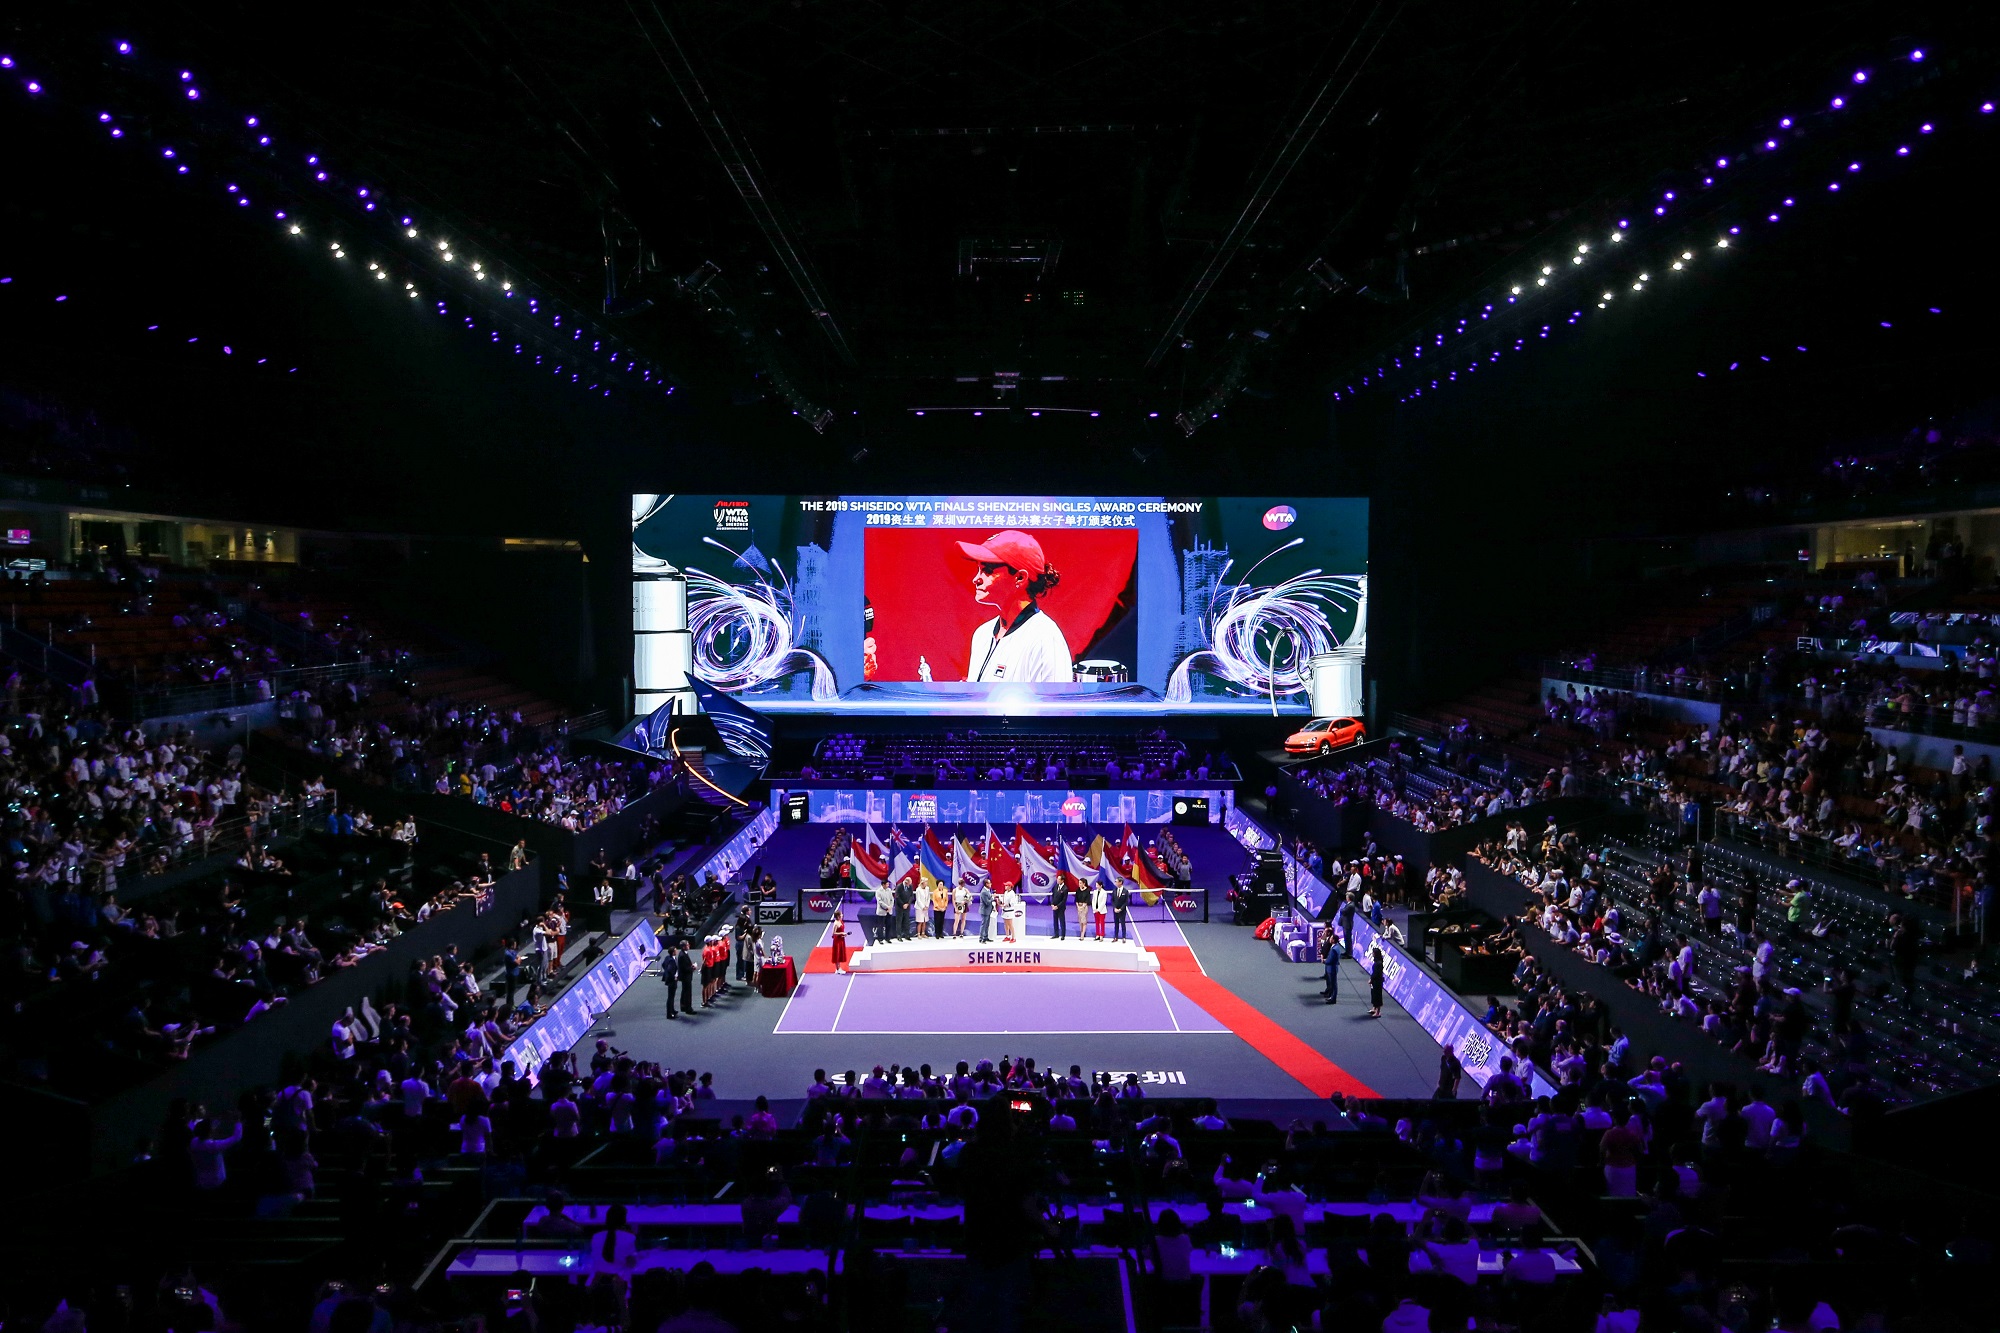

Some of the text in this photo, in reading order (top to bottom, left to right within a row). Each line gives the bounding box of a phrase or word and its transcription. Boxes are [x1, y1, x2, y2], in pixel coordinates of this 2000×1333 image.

[800, 500, 1203, 513] THE 2019 SHISEIDO WTA FINALS SHENZHEN SINGLES AWARD CEREMONY
[726, 508, 749, 516] WTA
[866, 514, 926, 526] 2019资生堂
[1265, 513, 1295, 523] WTA
[1063, 802, 1086, 811] WTA
[964, 872, 977, 885] WTA
[1033, 872, 1046, 885] WTA
[809, 900, 833, 908] WTA
[1174, 900, 1197, 908] WTA
[760, 910, 781, 920] SAP
[968, 951, 1041, 964] SHENZHEN
